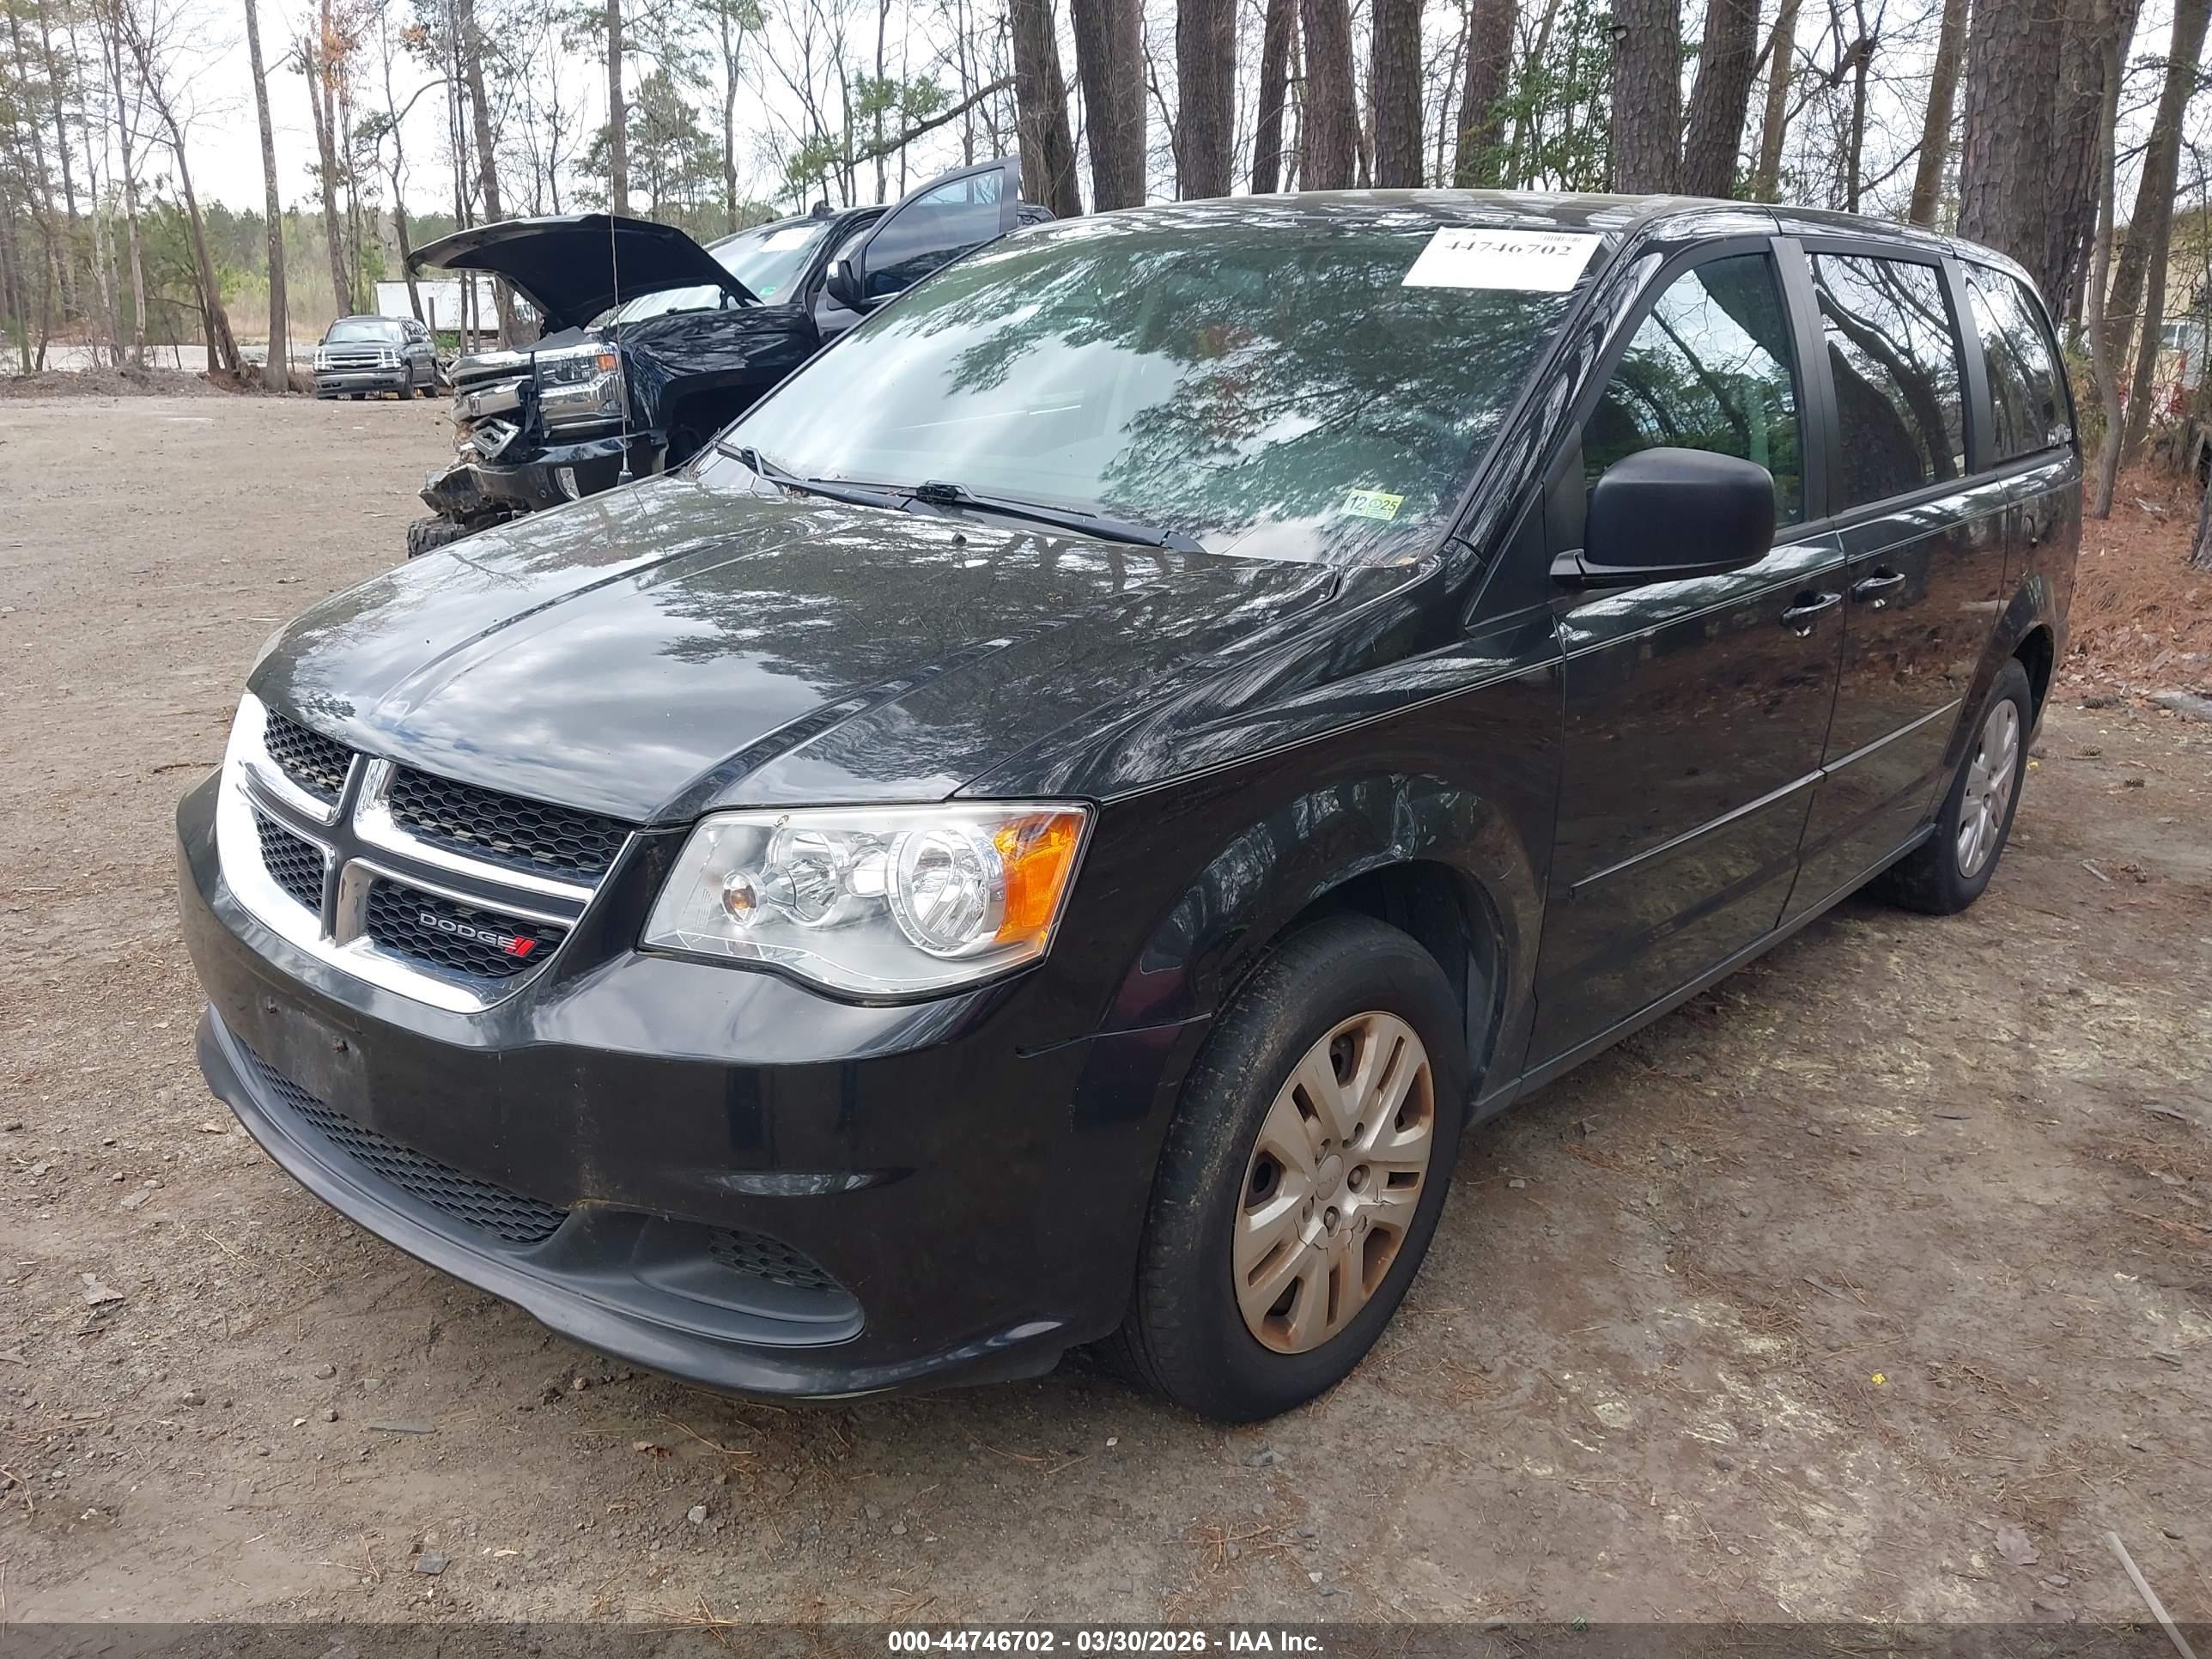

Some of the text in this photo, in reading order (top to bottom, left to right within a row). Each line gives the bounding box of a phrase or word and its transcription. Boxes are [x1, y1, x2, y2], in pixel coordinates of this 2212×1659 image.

[1444, 240, 1572, 256] 44746702
[1349, 495, 1368, 513] 12
[1381, 500, 1399, 512] 25
[419, 912, 518, 950] DODGE
